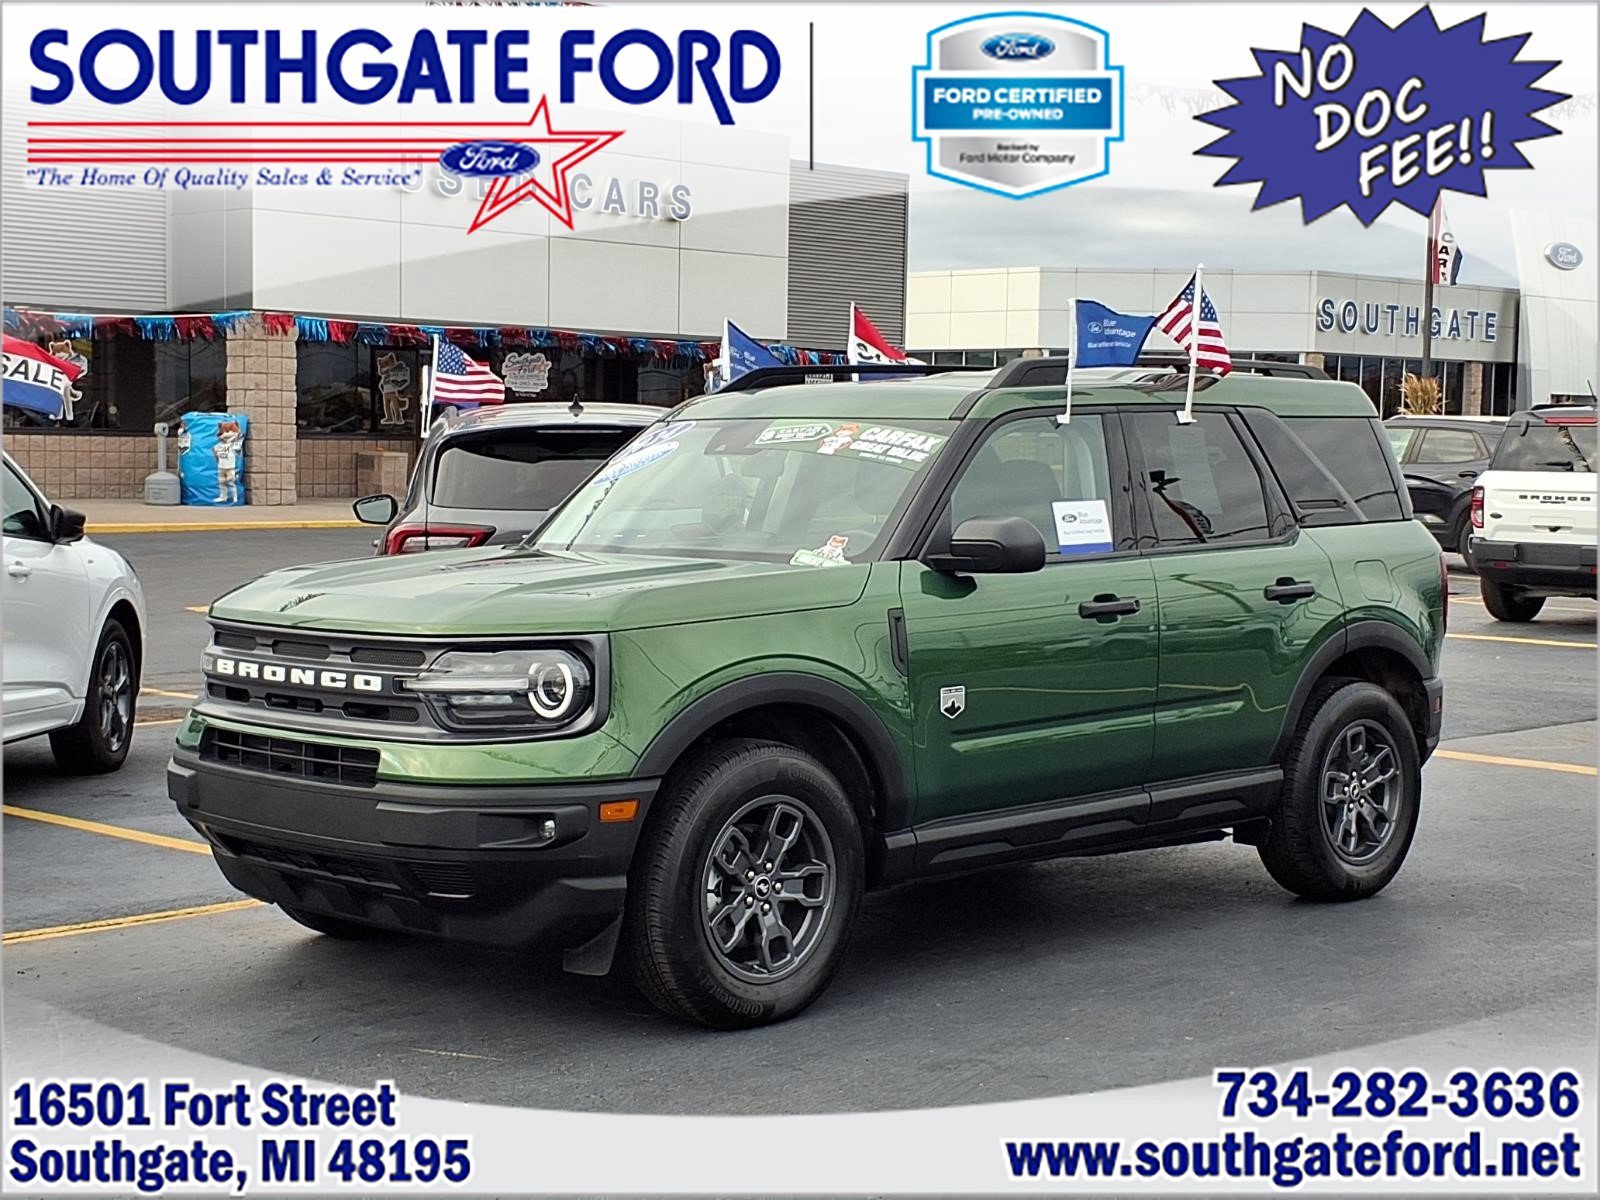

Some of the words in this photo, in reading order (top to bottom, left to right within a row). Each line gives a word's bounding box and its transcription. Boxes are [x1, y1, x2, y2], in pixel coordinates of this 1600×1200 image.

[570, 173, 693, 219] CARS
[1317, 298, 1498, 341] SOUTHGATE
[859, 427, 943, 452] CARFAX
[216, 658, 382, 692] BRONCO
